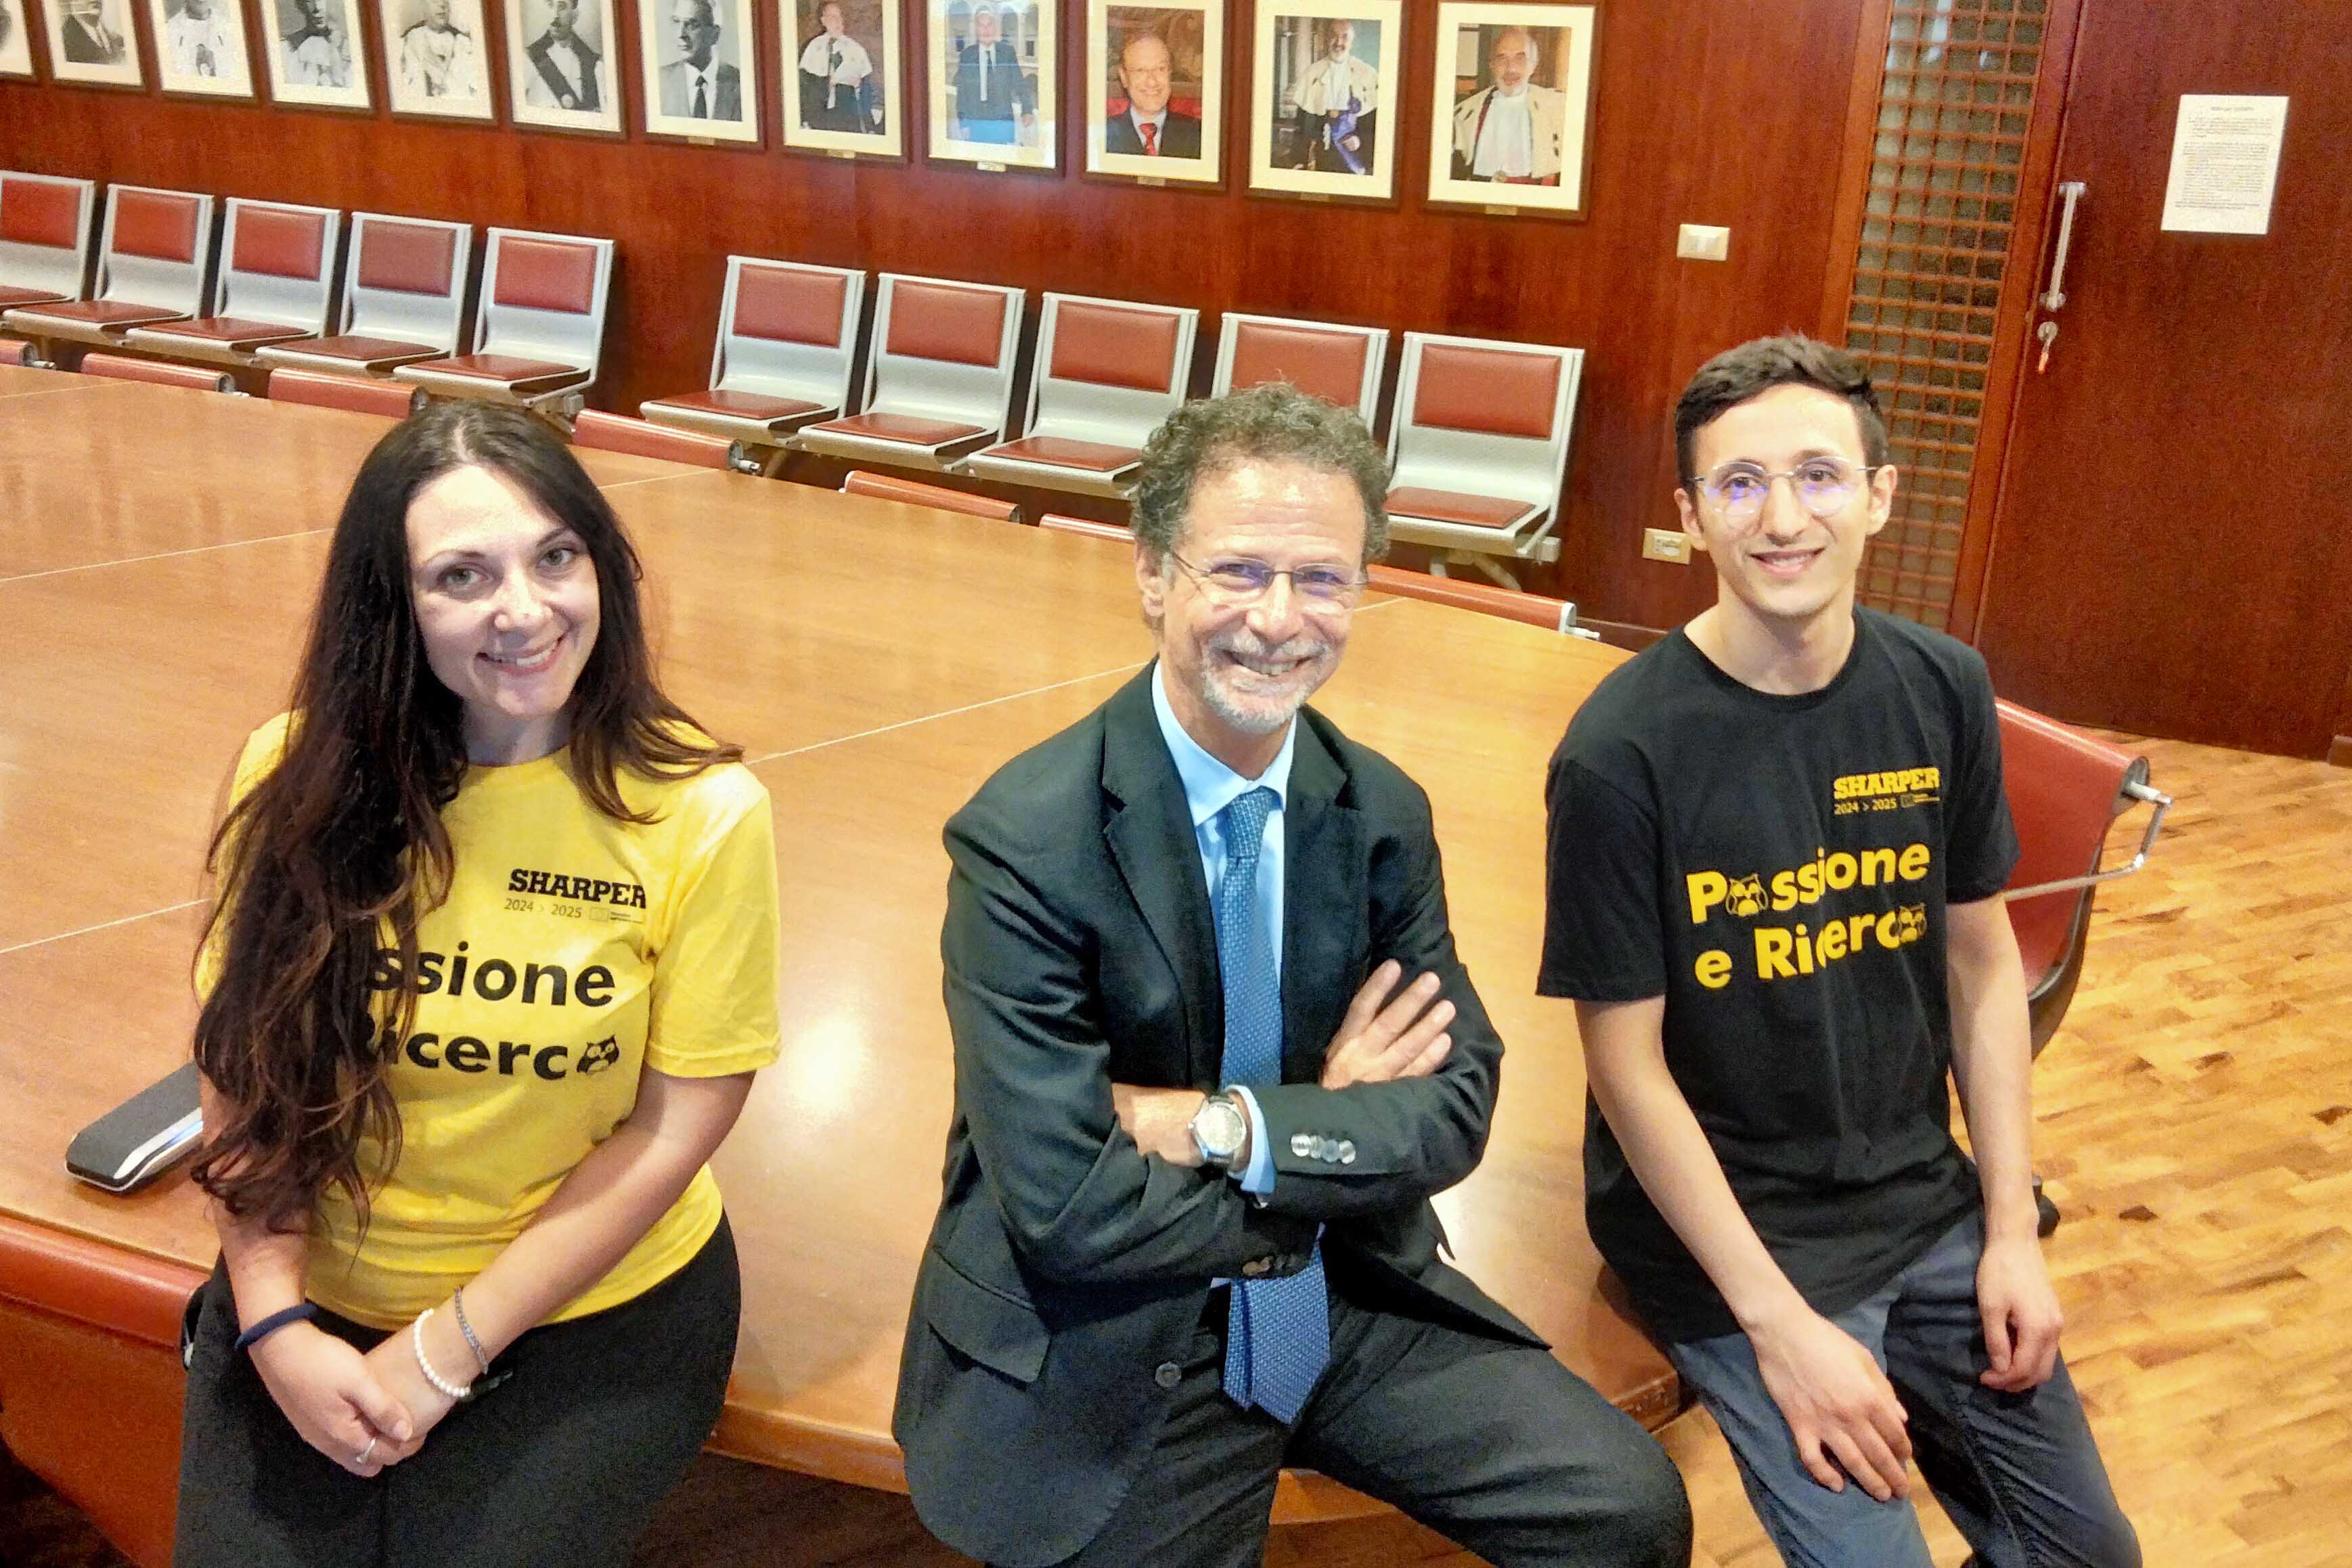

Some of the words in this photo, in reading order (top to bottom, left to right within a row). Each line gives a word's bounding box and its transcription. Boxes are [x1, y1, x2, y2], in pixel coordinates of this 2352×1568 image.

[1834, 767, 1940, 799] SHARPER
[1834, 801, 1859, 815] 2024
[1872, 798, 1898, 811] 2025
[508, 868, 646, 909] SHARPER
[504, 898, 534, 912] 2024
[551, 904, 582, 918] 2025
[1695, 949, 1733, 989] e
